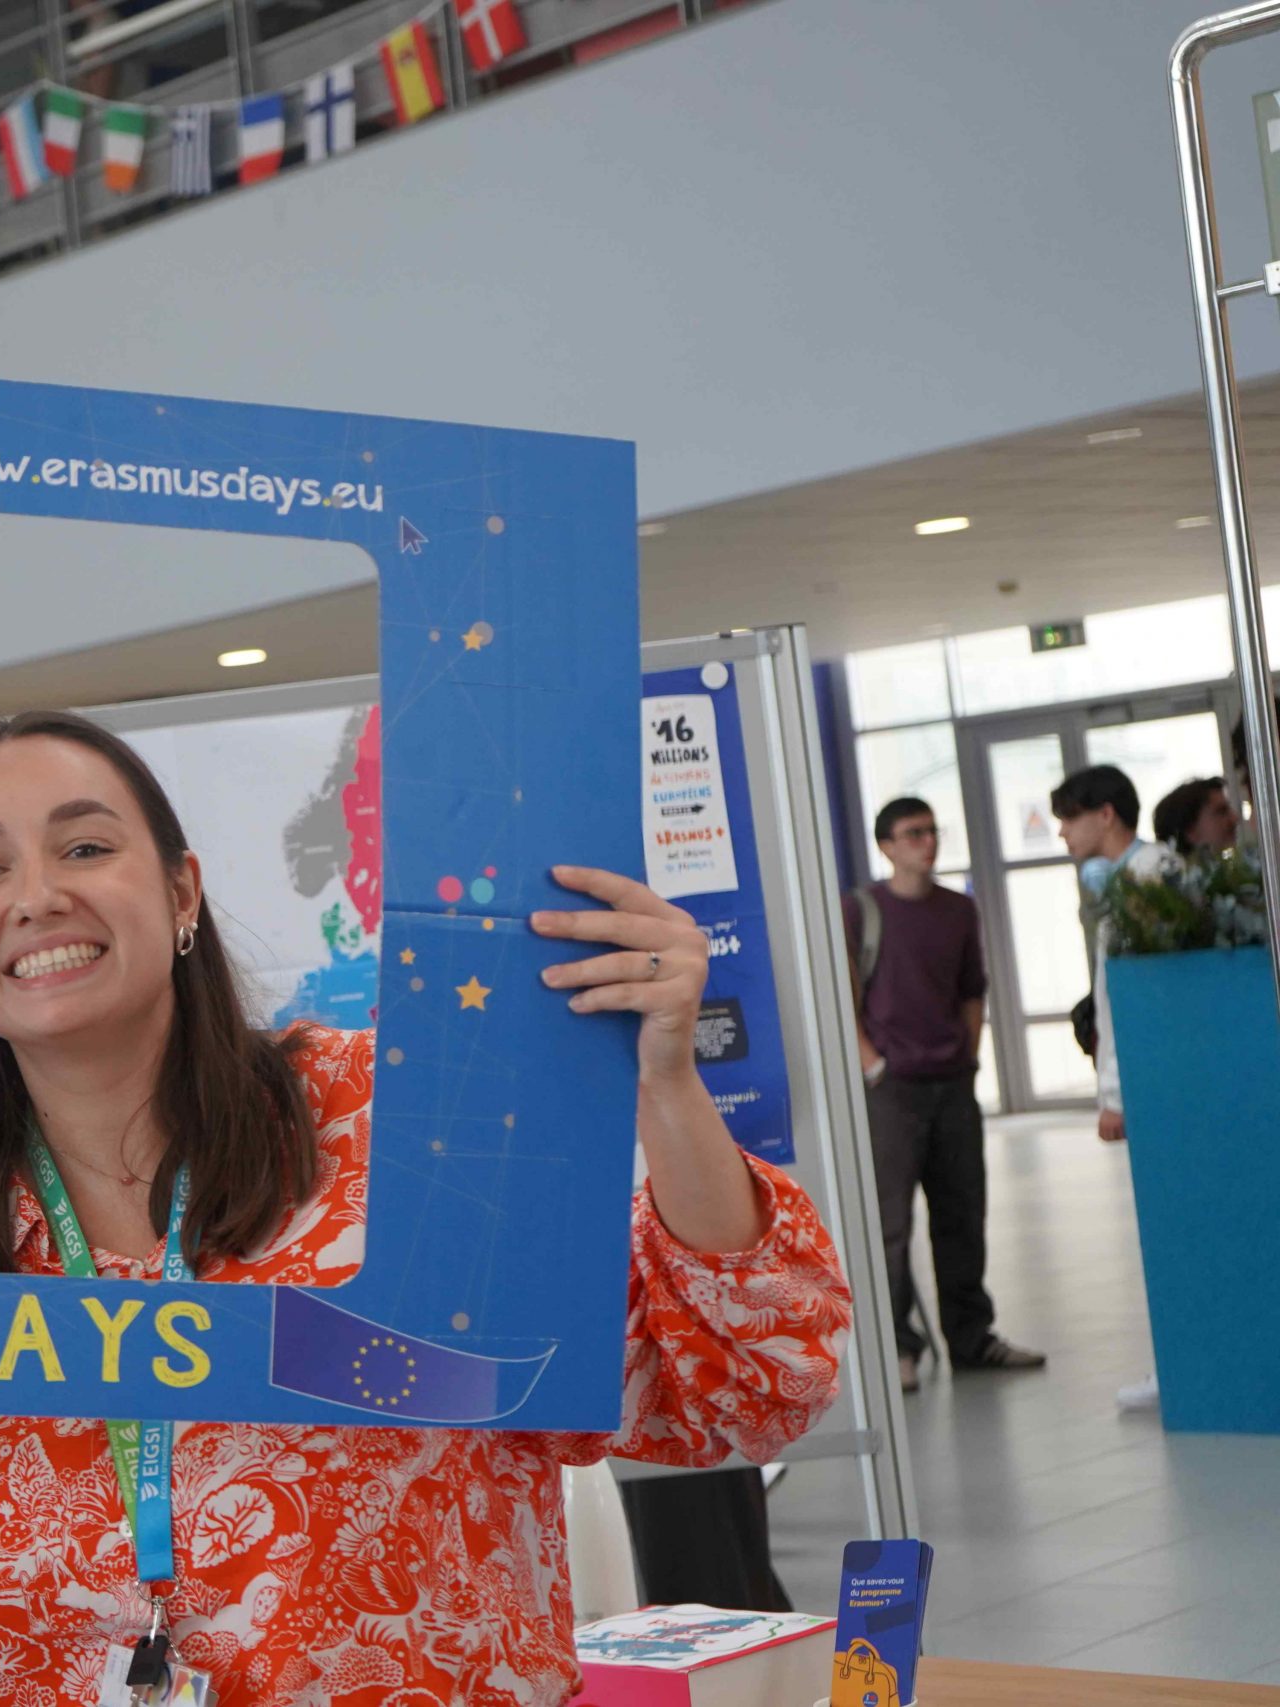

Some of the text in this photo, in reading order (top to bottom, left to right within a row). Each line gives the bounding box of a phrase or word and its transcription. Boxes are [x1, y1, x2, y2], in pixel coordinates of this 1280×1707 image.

[59, 1216, 84, 1260] EIGSI
[166, 1253, 184, 1281] GSI
[142, 1427, 161, 1477] EIGSI
[851, 1577, 905, 1587] Que savez-vous
[850, 1588, 902, 1598] du programme
[849, 1599, 885, 1607] Erasmus+
